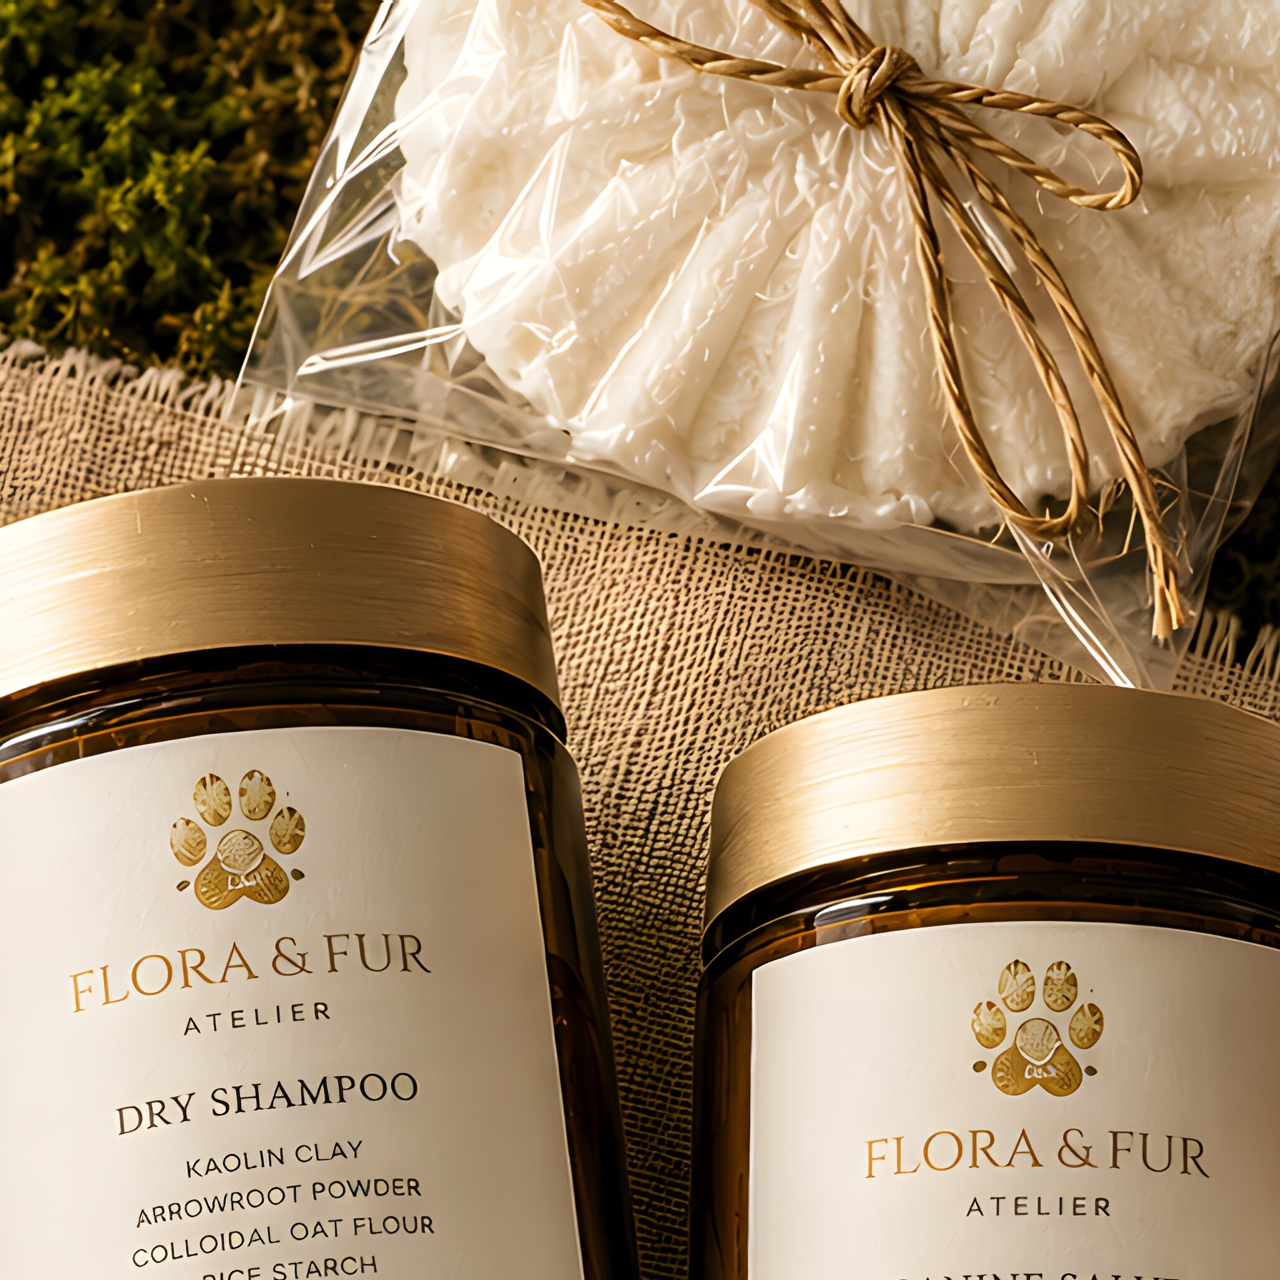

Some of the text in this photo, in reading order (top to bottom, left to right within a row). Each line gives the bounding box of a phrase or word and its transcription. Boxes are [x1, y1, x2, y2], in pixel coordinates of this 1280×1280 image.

[69, 933, 431, 1013] FLORA & FUR
[184, 1002, 330, 1036] ATELIER
[116, 1073, 417, 1135] DRY SHAMPOO
[186, 1140, 362, 1178] KAOLIN CLAY
[865, 1128, 1209, 1179] FLORA & FUR
[136, 1178, 421, 1228] ARROWROOT POWDER
[966, 1196, 1110, 1217] ATELIER
[132, 1216, 434, 1267] COLLOIDAL OAT FLOUR
